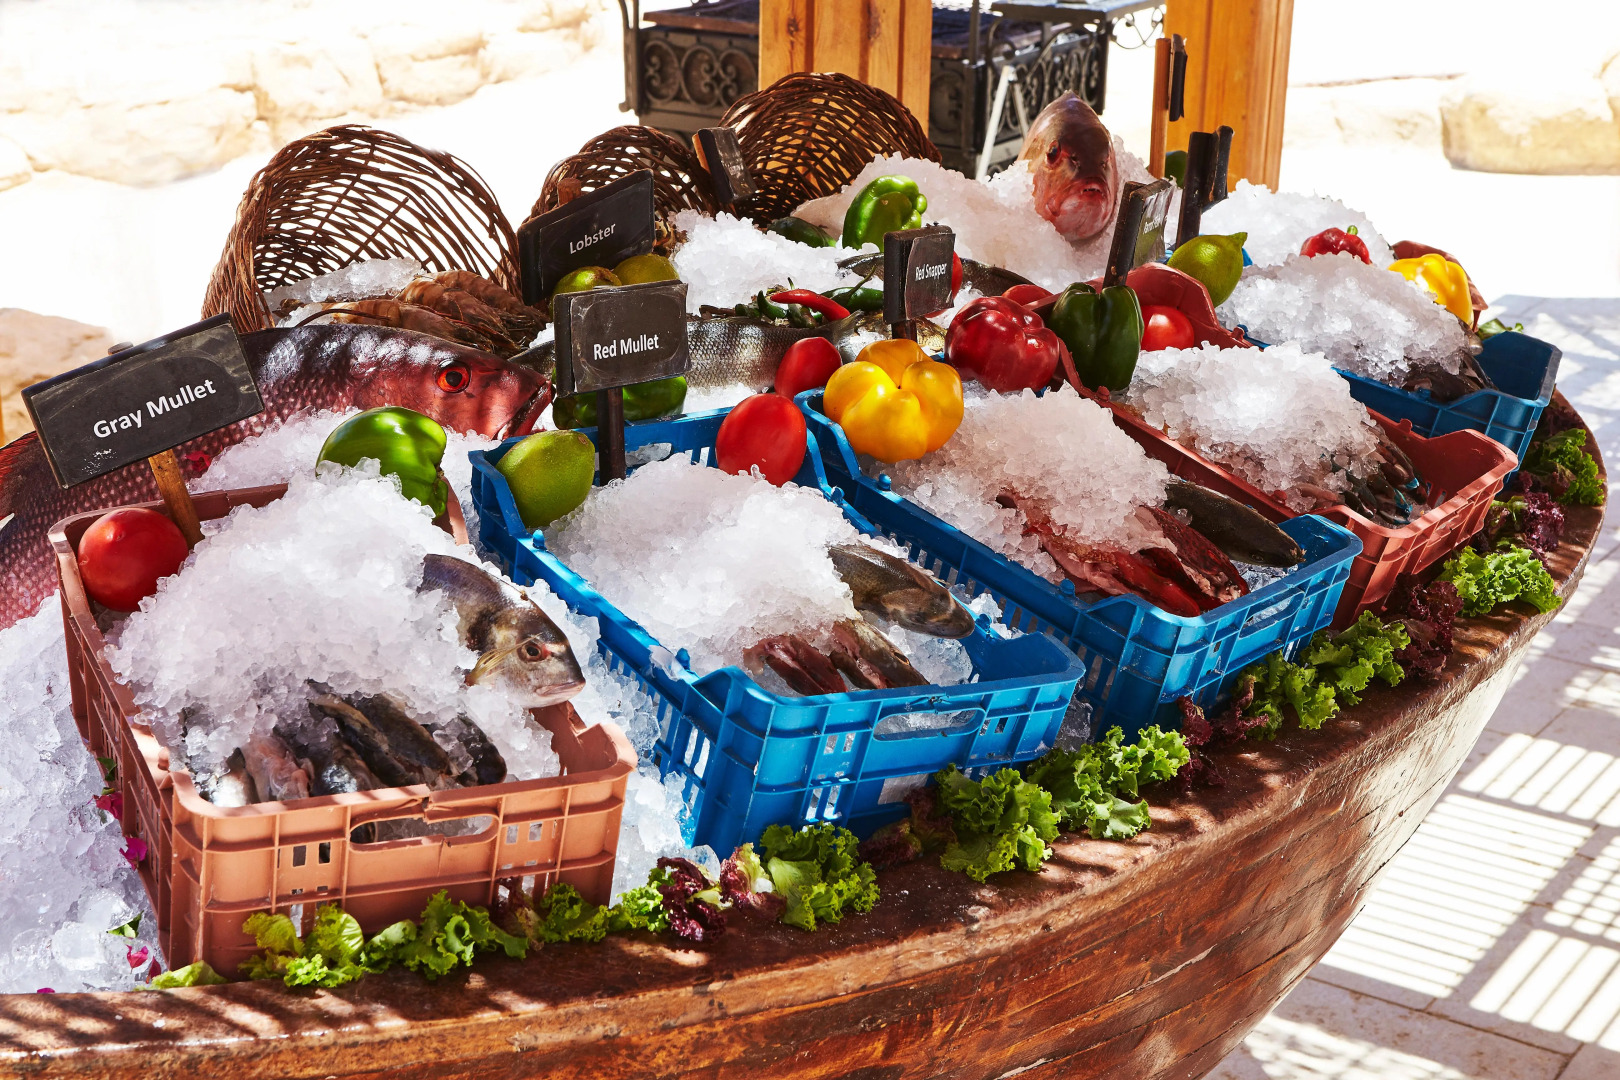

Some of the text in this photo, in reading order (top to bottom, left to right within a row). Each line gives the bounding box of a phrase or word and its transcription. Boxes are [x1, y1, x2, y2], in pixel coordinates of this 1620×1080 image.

[569, 223, 616, 254] Lobster
[915, 263, 947, 281] Red Snapper
[593, 334, 659, 360] Red Mullet
[93, 379, 217, 438] Gray Mullet
